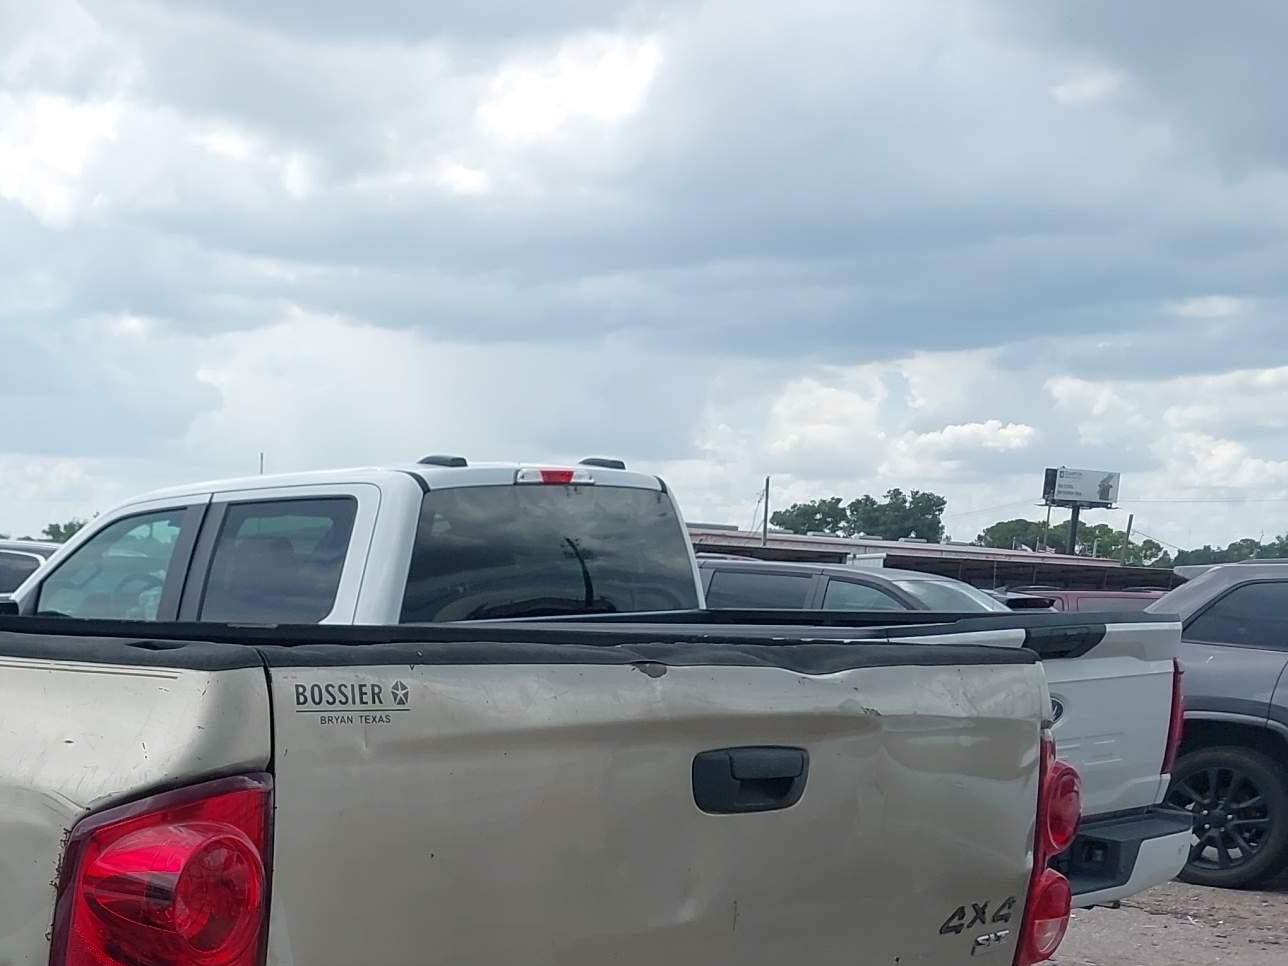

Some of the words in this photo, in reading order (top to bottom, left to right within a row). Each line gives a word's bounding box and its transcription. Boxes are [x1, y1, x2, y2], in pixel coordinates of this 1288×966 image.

[294, 683, 384, 706] BOSSIER
[319, 714, 354, 725] BRYAN
[359, 714, 392, 725] TEXAS
